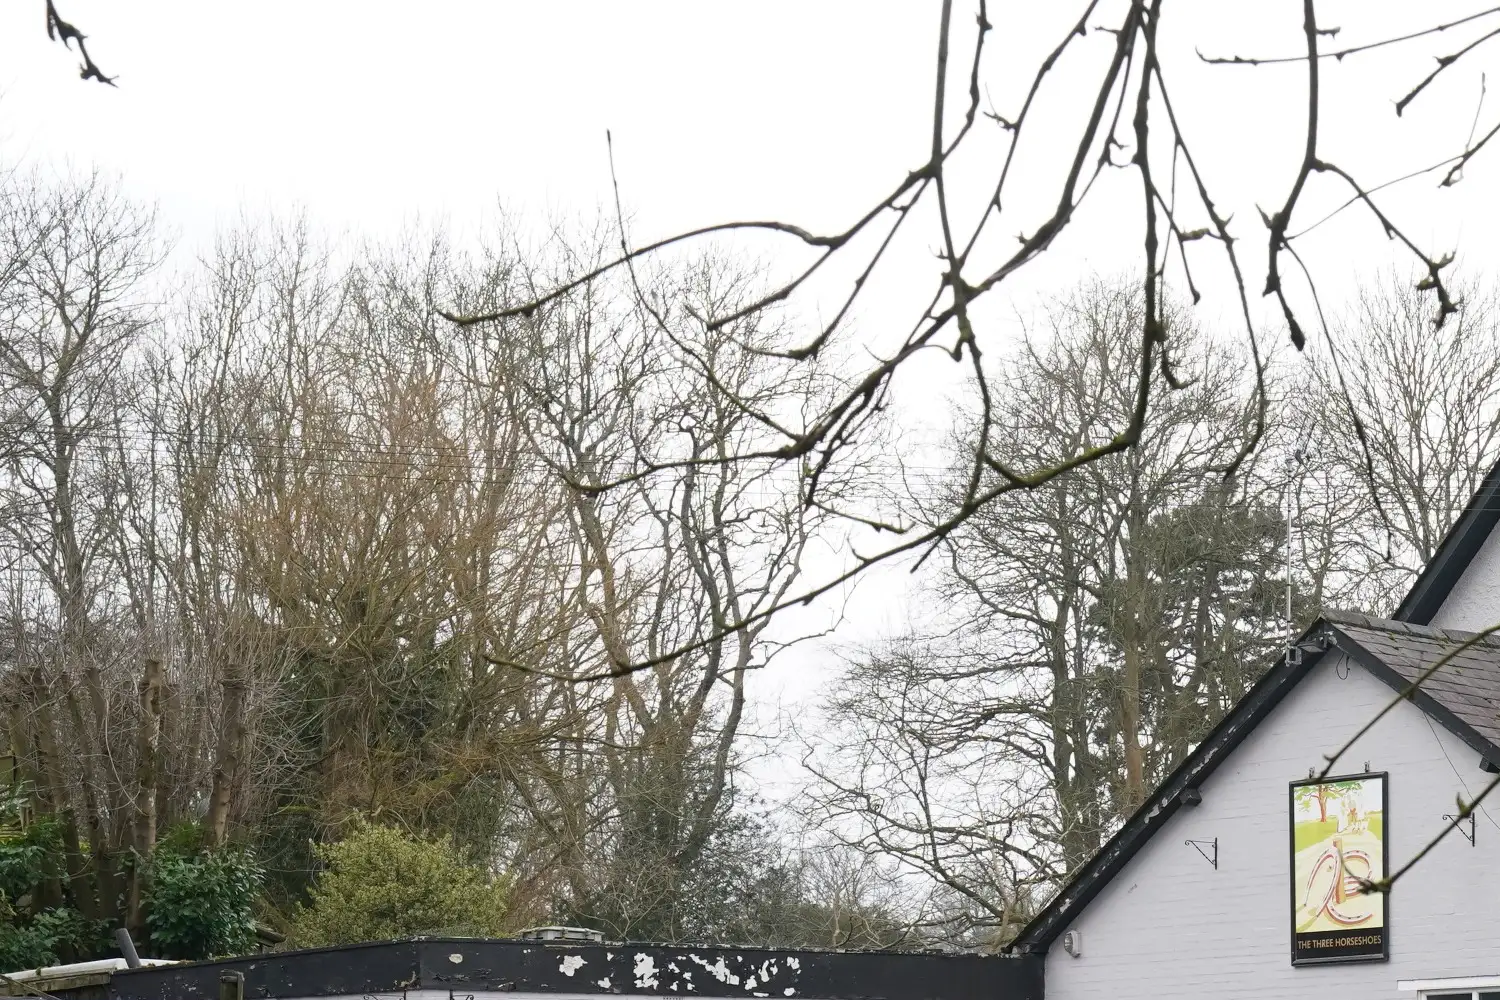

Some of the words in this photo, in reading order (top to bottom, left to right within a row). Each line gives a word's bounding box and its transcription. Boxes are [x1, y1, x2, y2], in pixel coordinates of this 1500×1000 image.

[1298, 940, 1312, 950] THE
[1313, 938, 1334, 949] THREE
[1335, 935, 1382, 947] HORSESHOES
